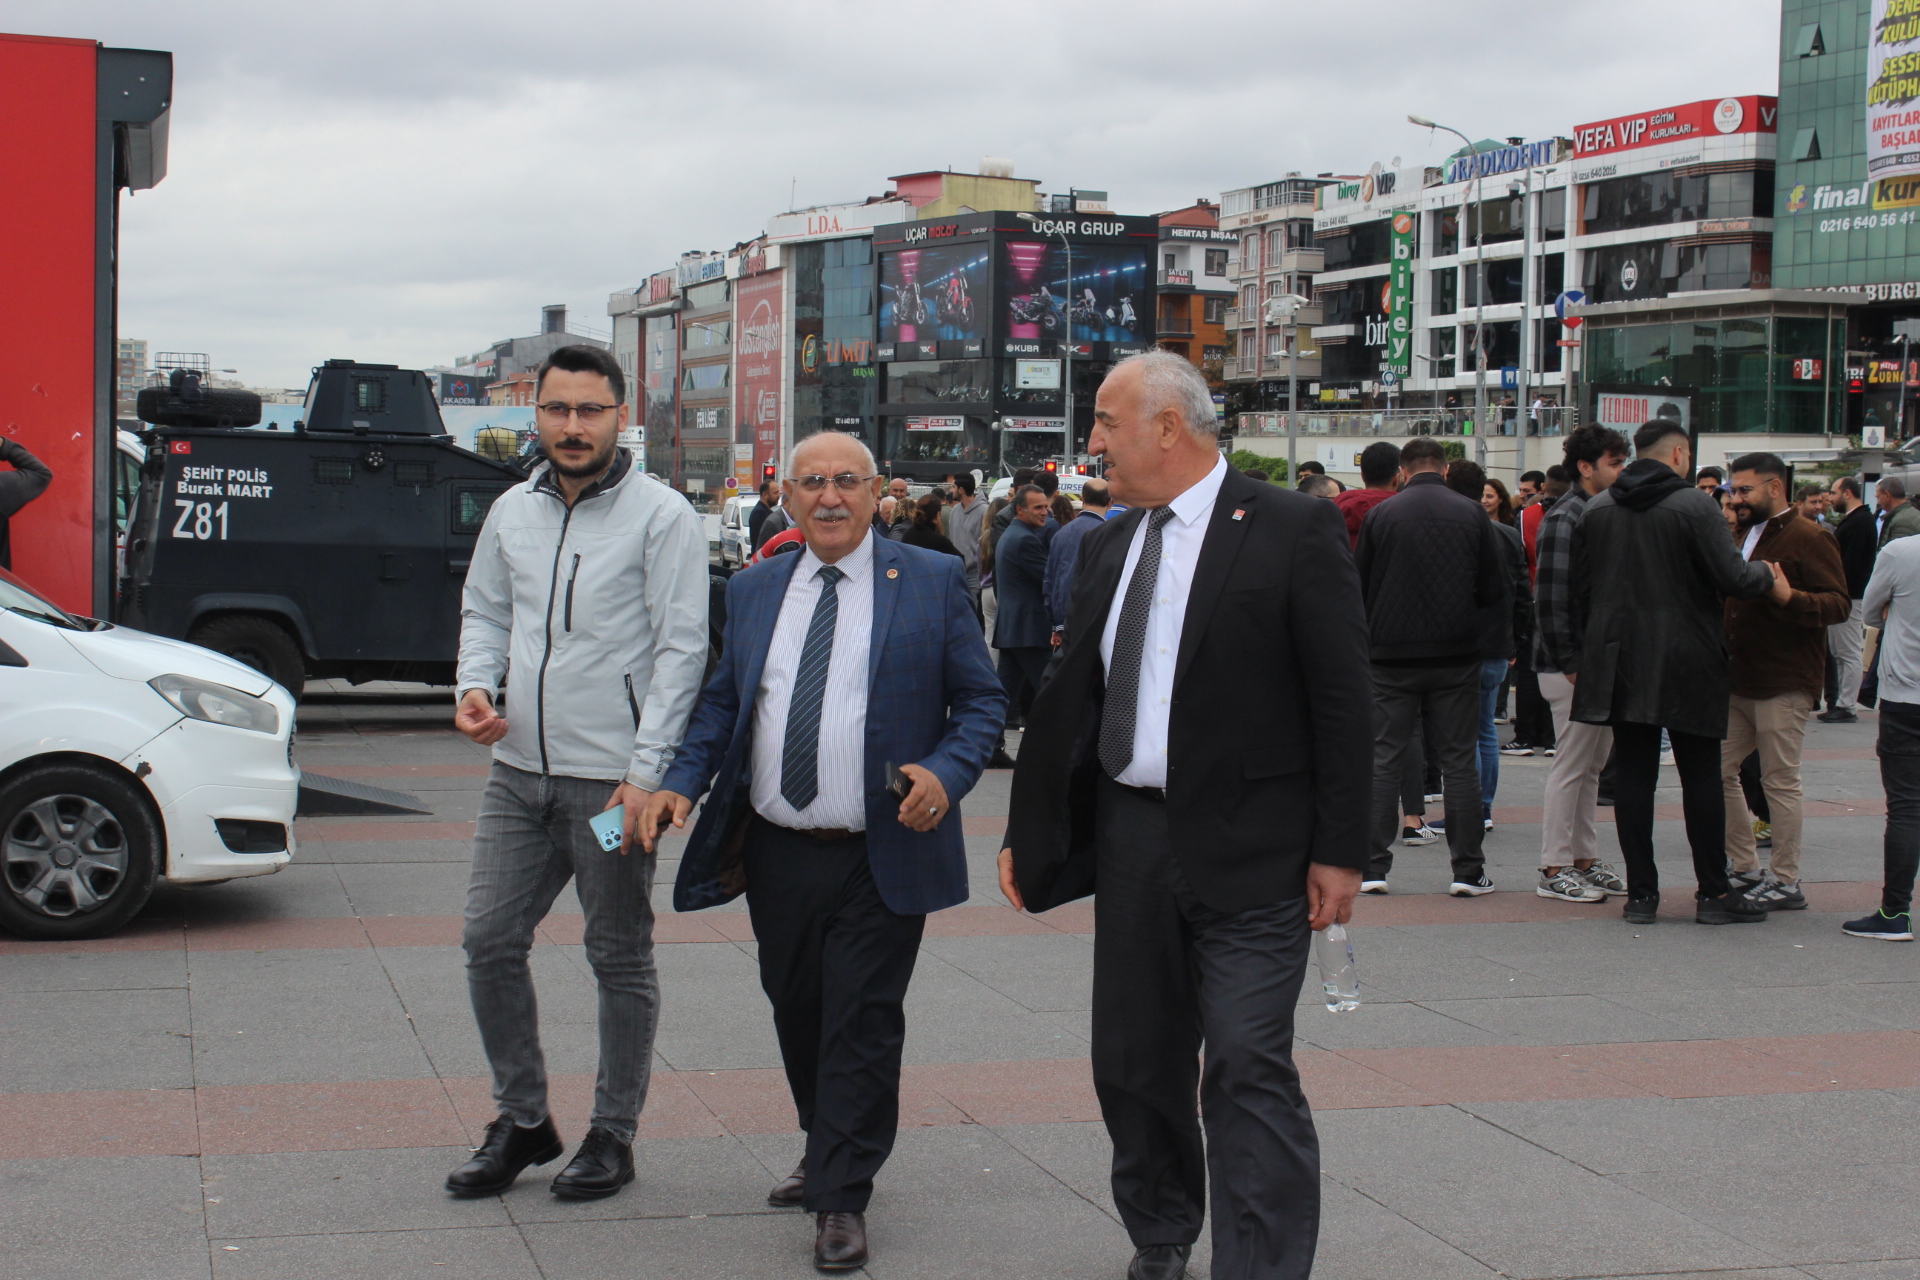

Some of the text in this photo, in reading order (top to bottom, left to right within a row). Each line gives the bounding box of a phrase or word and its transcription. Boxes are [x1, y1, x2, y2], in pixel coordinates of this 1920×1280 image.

[1867, 77, 1920, 106] KÜTÜPH
[1650, 111, 1676, 126] EĞİTİM
[1573, 118, 1648, 153] VEFA VIP
[1650, 123, 1692, 141] KURUMLARI
[1337, 182, 1361, 201] birey
[1813, 181, 1871, 210] final
[807, 213, 843, 236] L.D.A.
[1032, 219, 1125, 237] UÇAR GRUP
[1820, 210, 1916, 233] 0216 640 56 41
[905, 227, 927, 244] UÇAR
[1171, 228, 1208, 240] HEMTAŞ
[1014, 344, 1040, 353] KUBA
[1268, 382, 1301, 392] BERBR
[1602, 397, 1648, 424] TEOMAN
[182, 464, 268, 484] ŞEHİT POLİS
[177, 480, 273, 498] Burak MART
[172, 498, 229, 541] Z81
